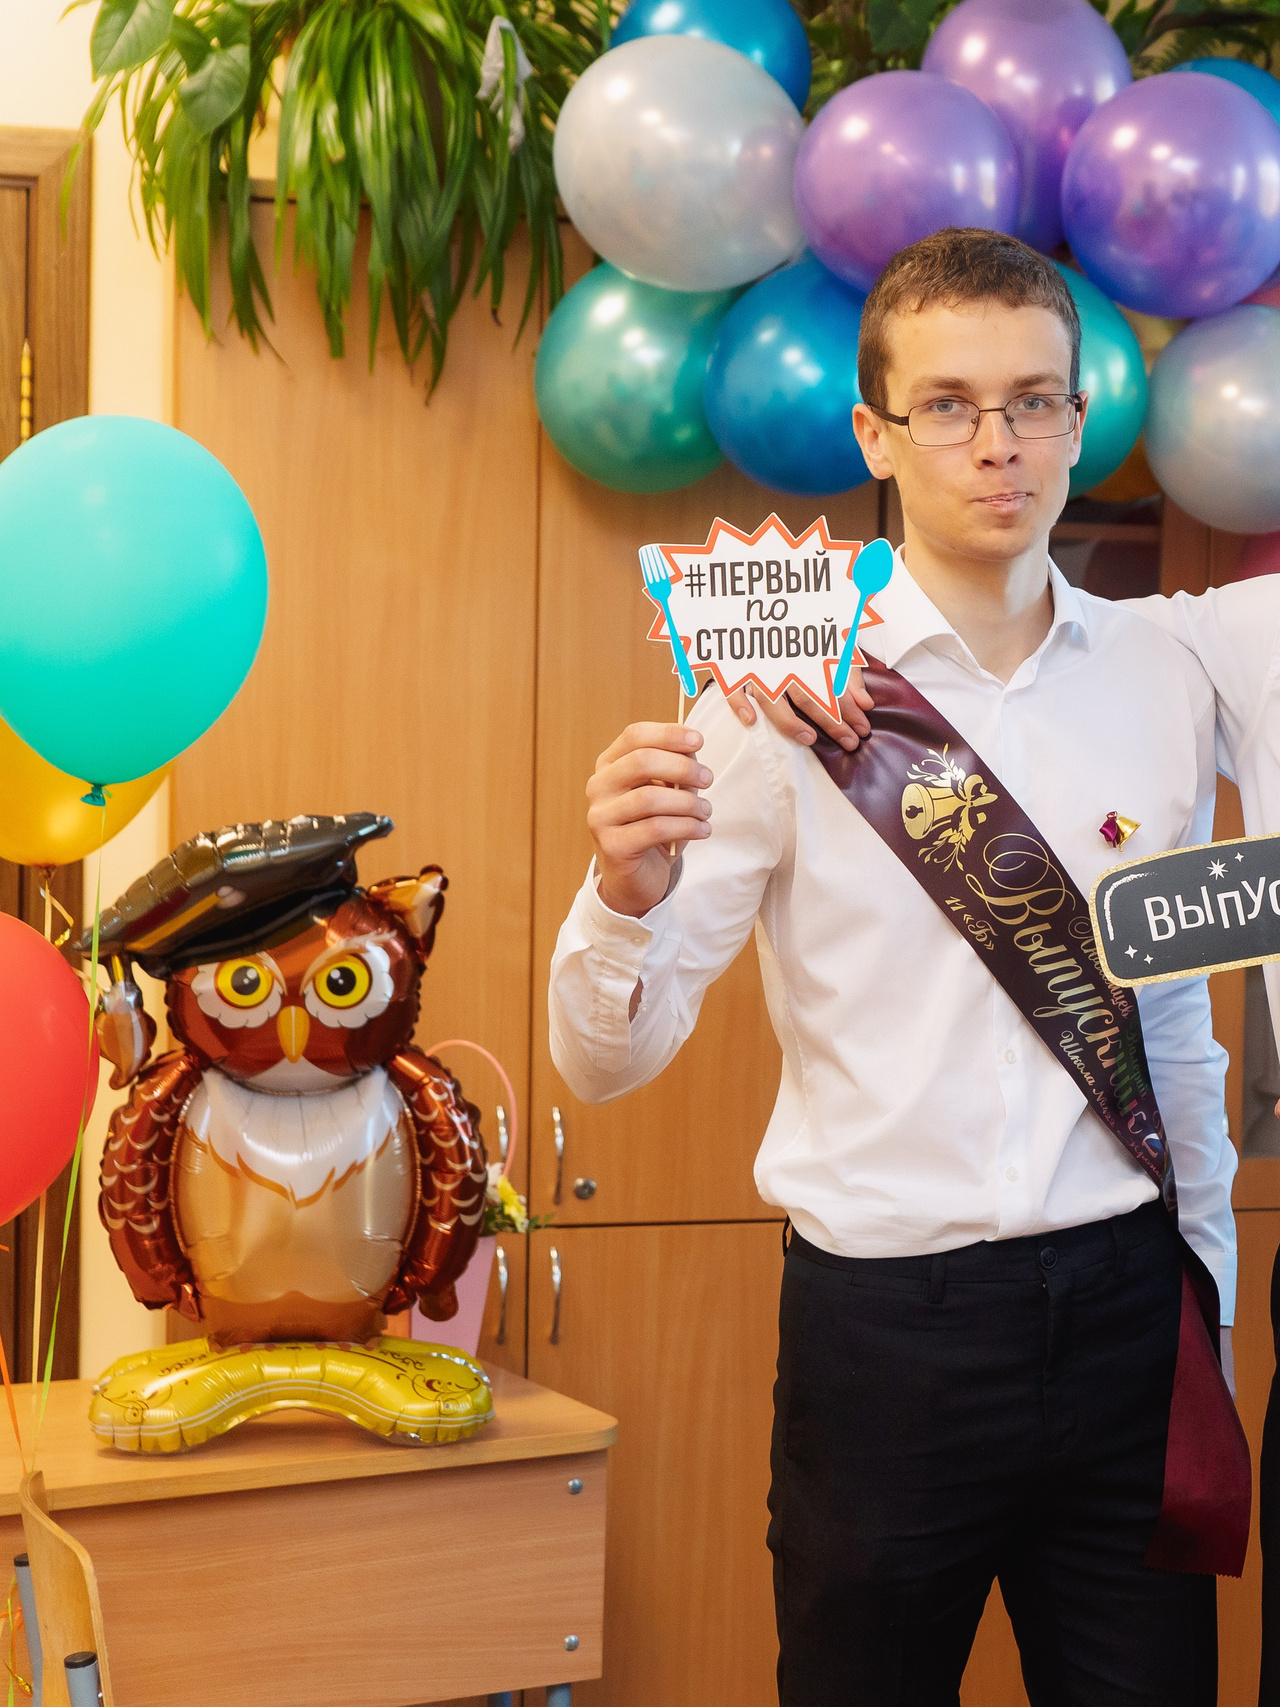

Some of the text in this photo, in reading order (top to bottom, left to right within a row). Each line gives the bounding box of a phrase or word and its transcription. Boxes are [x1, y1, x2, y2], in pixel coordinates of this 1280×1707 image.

[684, 550, 831, 597] #ПЕРВЫЙ
[746, 598, 788, 622] по
[696, 617, 838, 661] СТОЛОВОЙ
[945, 896, 967, 912] 11
[966, 833, 1147, 1135] Выпускник
[1059, 1030, 1096, 1086] Школа
